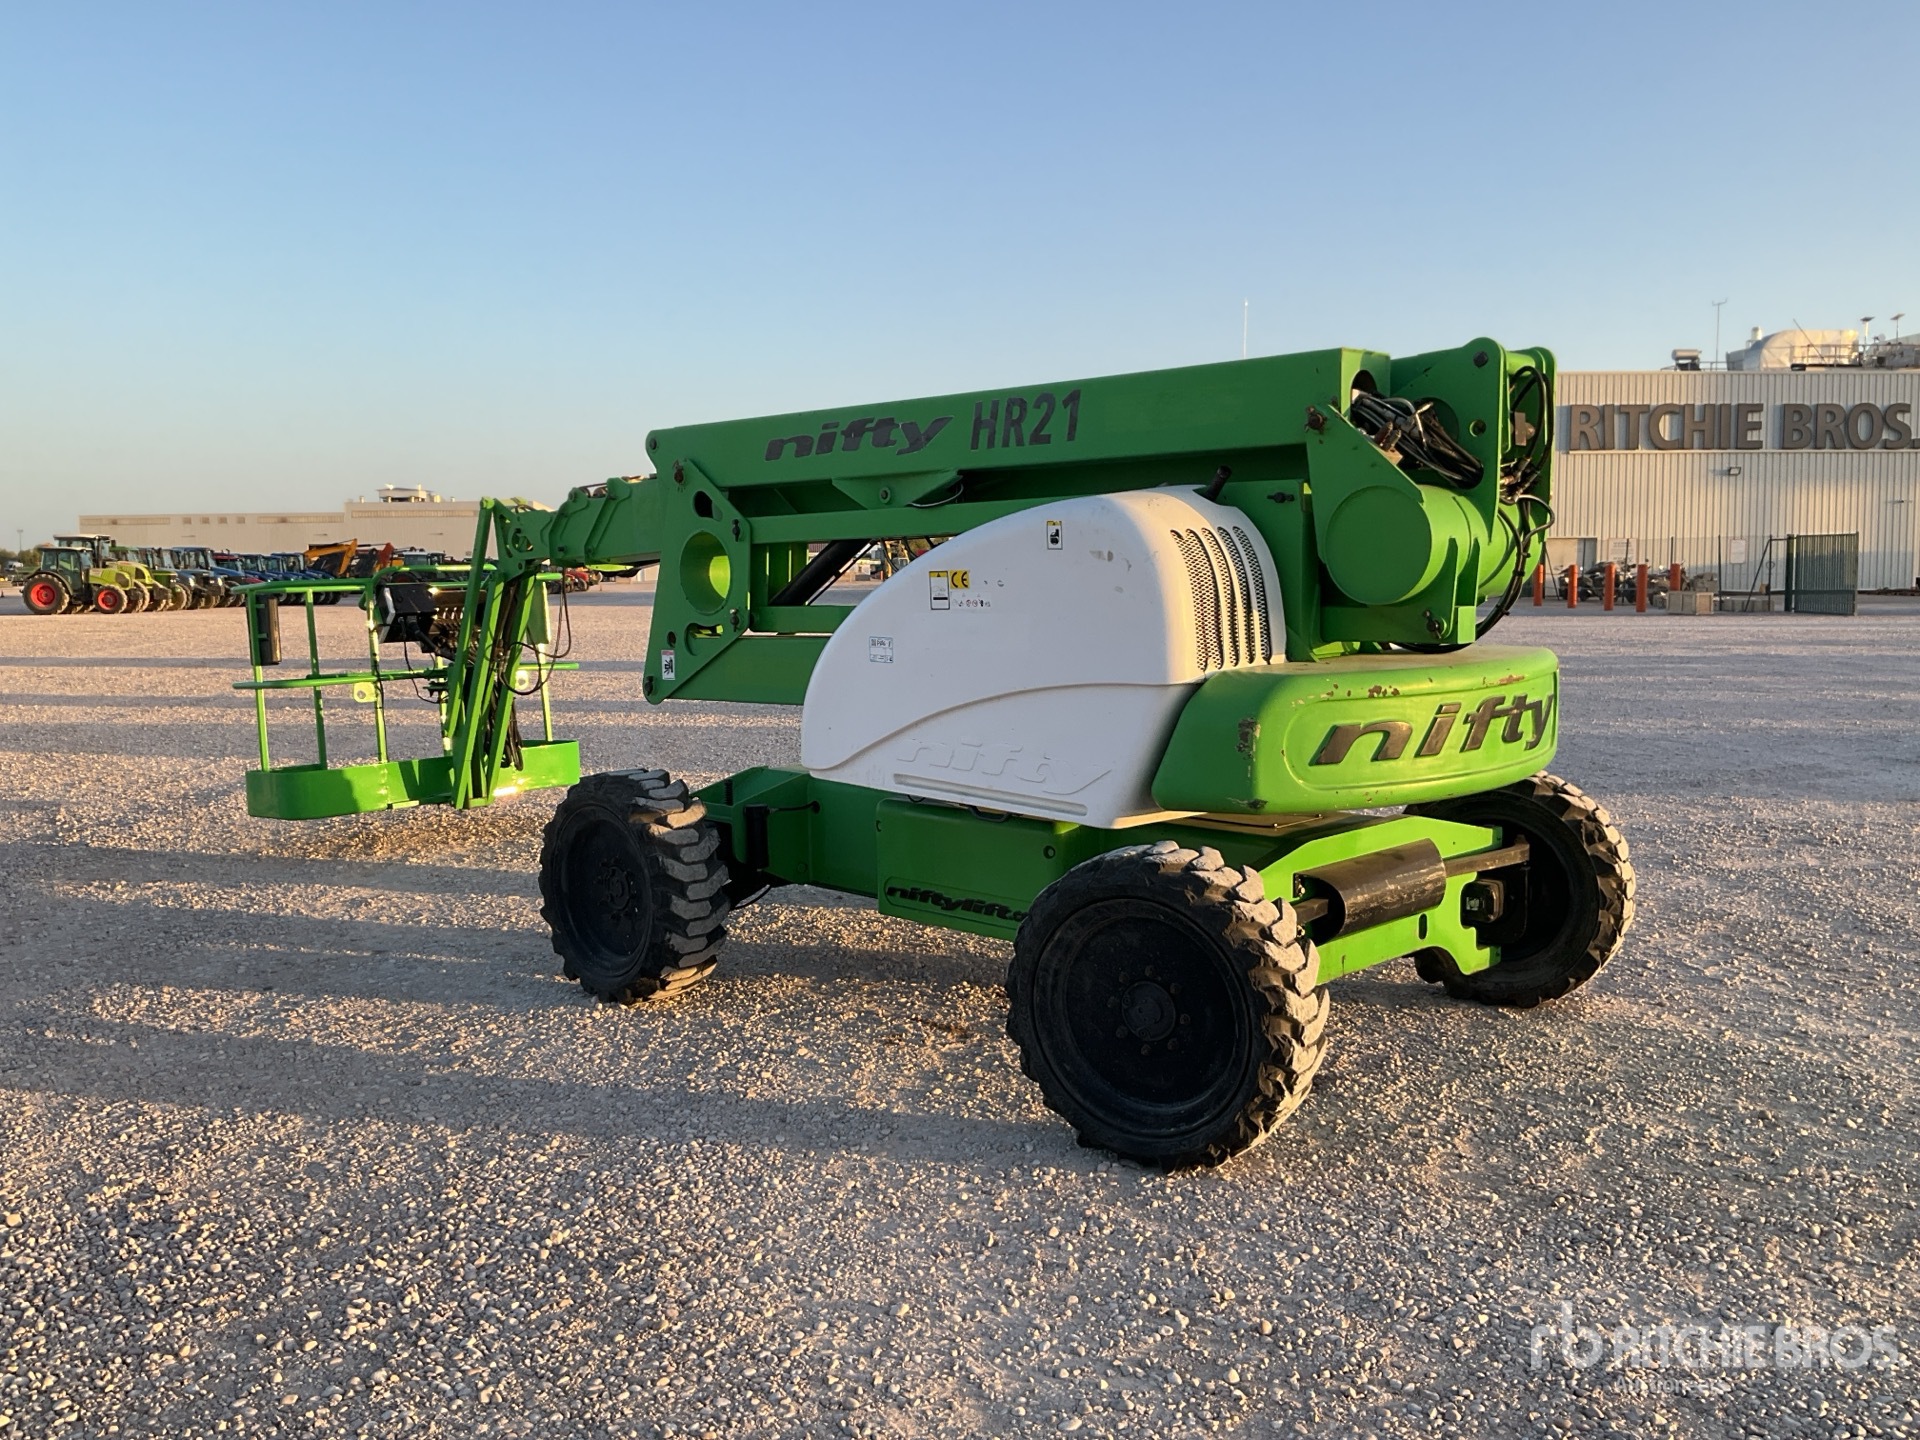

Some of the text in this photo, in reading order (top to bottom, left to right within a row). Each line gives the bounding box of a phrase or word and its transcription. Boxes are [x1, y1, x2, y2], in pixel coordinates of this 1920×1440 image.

[764, 389, 1082, 462] nifty HR21
[1569, 403, 1764, 450] RITCHIE
[1309, 692, 1555, 767] nifty
